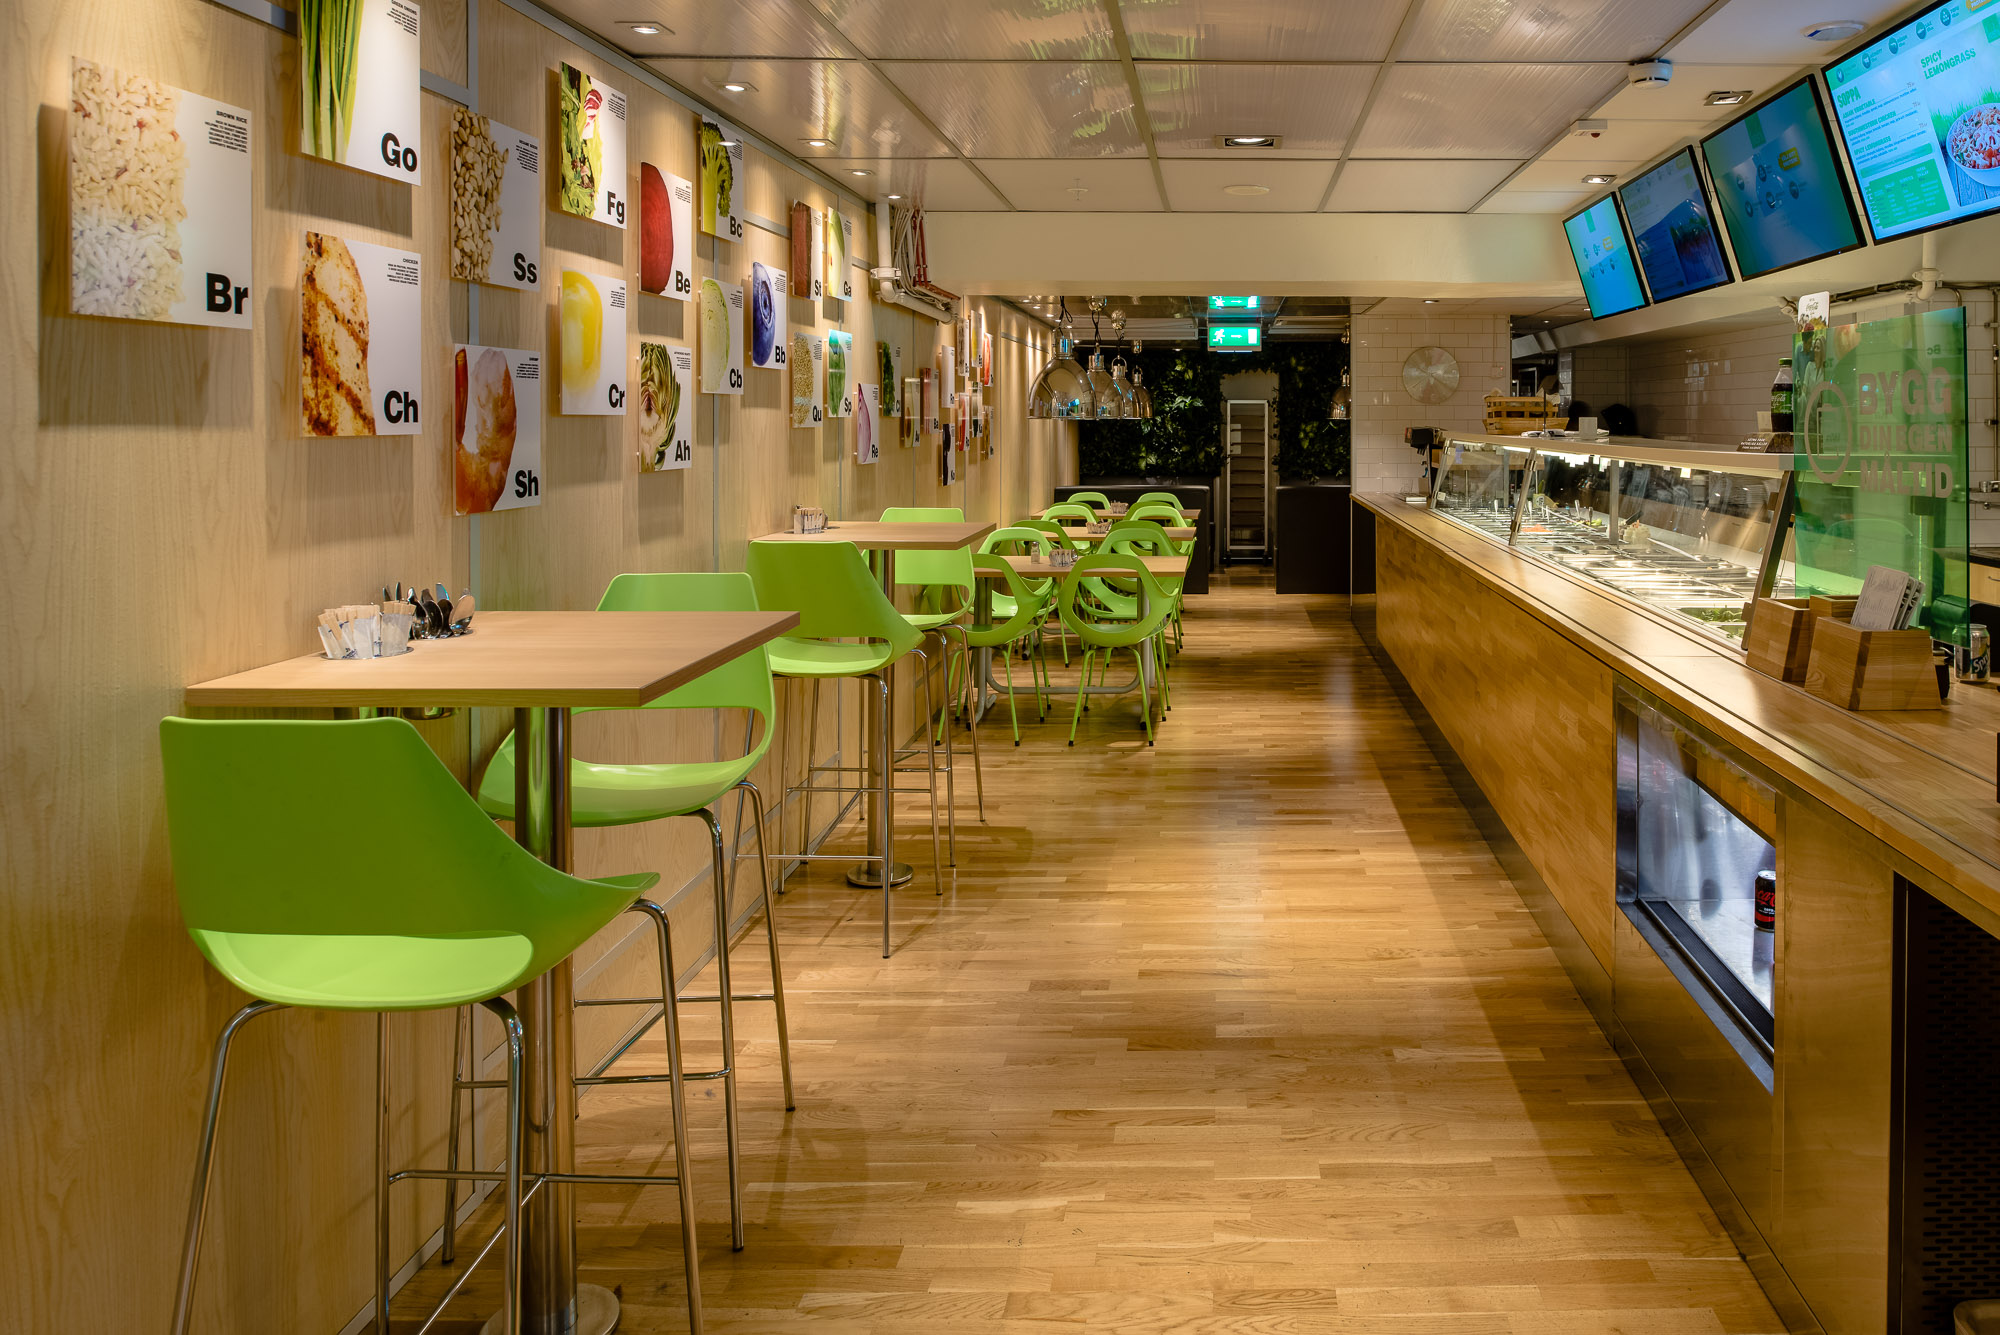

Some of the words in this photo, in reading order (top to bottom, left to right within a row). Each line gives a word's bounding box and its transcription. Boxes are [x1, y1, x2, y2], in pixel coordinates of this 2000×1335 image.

[1921, 50, 1942, 68] SPICY
[1923, 48, 1977, 80] LEMONGRASS
[1837, 86, 1861, 108] SOPPA
[381, 132, 418, 172] Go
[607, 191, 625, 225] Fg
[730, 215, 743, 238] Bc
[513, 252, 537, 284] Ss
[206, 272, 248, 315] Br
[675, 270, 691, 294] Be
[775, 345, 786, 364] Bb
[729, 368, 743, 388] Cb
[608, 383, 625, 408] Cr
[1859, 367, 1953, 415] BYGG
[384, 390, 419, 424] Ch
[812, 405, 822, 422] Qu
[844, 397, 852, 416] Sp
[675, 440, 691, 461] Ah
[1859, 425, 1892, 451] DIN
[1895, 424, 1953, 452] EGEN
[871, 444, 879, 458] Re
[515, 470, 539, 498] Sh
[1860, 451, 1953, 499] MÅLTID
